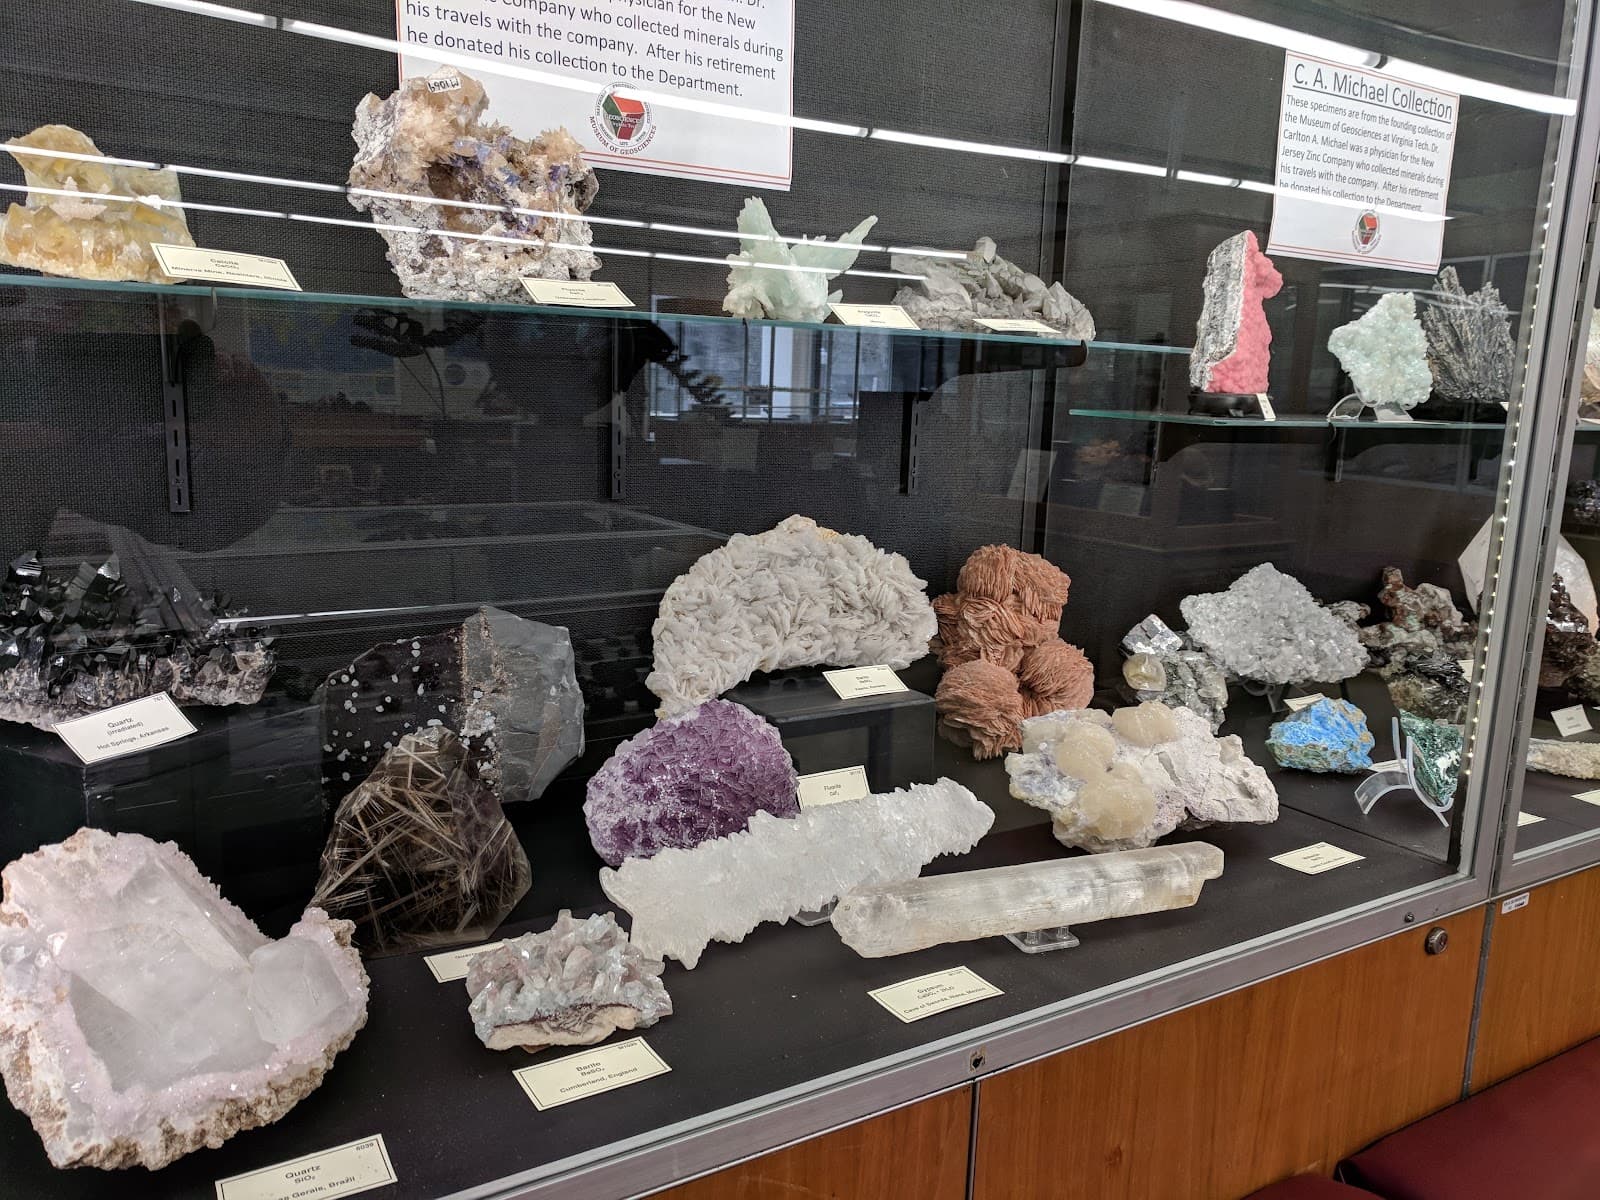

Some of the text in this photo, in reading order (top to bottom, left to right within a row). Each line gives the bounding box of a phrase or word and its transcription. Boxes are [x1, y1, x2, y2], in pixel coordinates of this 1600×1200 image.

[580, 7, 612, 24] who
[616, 14, 679, 37] collected
[683, 28, 740, 50] minerals
[743, 38, 784, 61] during
[609, 0, 756, 30] ysician for the New
[406, 0, 776, 80] his travels with the company. After his retirement
[407, 25, 743, 97] he donated his collection to the Department.
[1294, 63, 1453, 121] C. A. Michael Collection
[589, 116, 609, 148] MUSEUM
[609, 145, 620, 153] OF
[620, 125, 657, 155] GEOSCIENCES
[1284, 111, 1440, 153] the Museum of Geosciences at Virginia Tech. Dr.
[1286, 94, 1309, 109] These
[1310, 102, 1347, 117] specimens
[1348, 109, 1360, 119] are
[1361, 110, 1377, 122] from
[1378, 114, 1390, 126] the
[1390, 116, 1417, 134] founding
[1417, 126, 1445, 139] collection
[1282, 146, 1445, 188] Jersey Zinc Company who collected minerals during
[1283, 128, 1435, 168] Carlton A. Michael was a physician for the New
[1280, 162, 1439, 200] his travels with the company. After his retirement
[1366, 195, 1374, 204] to
[1374, 196, 1386, 206] the
[107, 717, 134, 729] Quartz
[107, 721, 144, 737] (irradiated)
[139, 726, 170, 738] Arkansas
[559, 1067, 638, 1093] Cumberland, England
[576, 1062, 602, 1072] Barite
[285, 1165, 321, 1179] Quartz
[291, 1186, 327, 1199] Gerais,
[328, 1176, 356, 1189] Brazil
